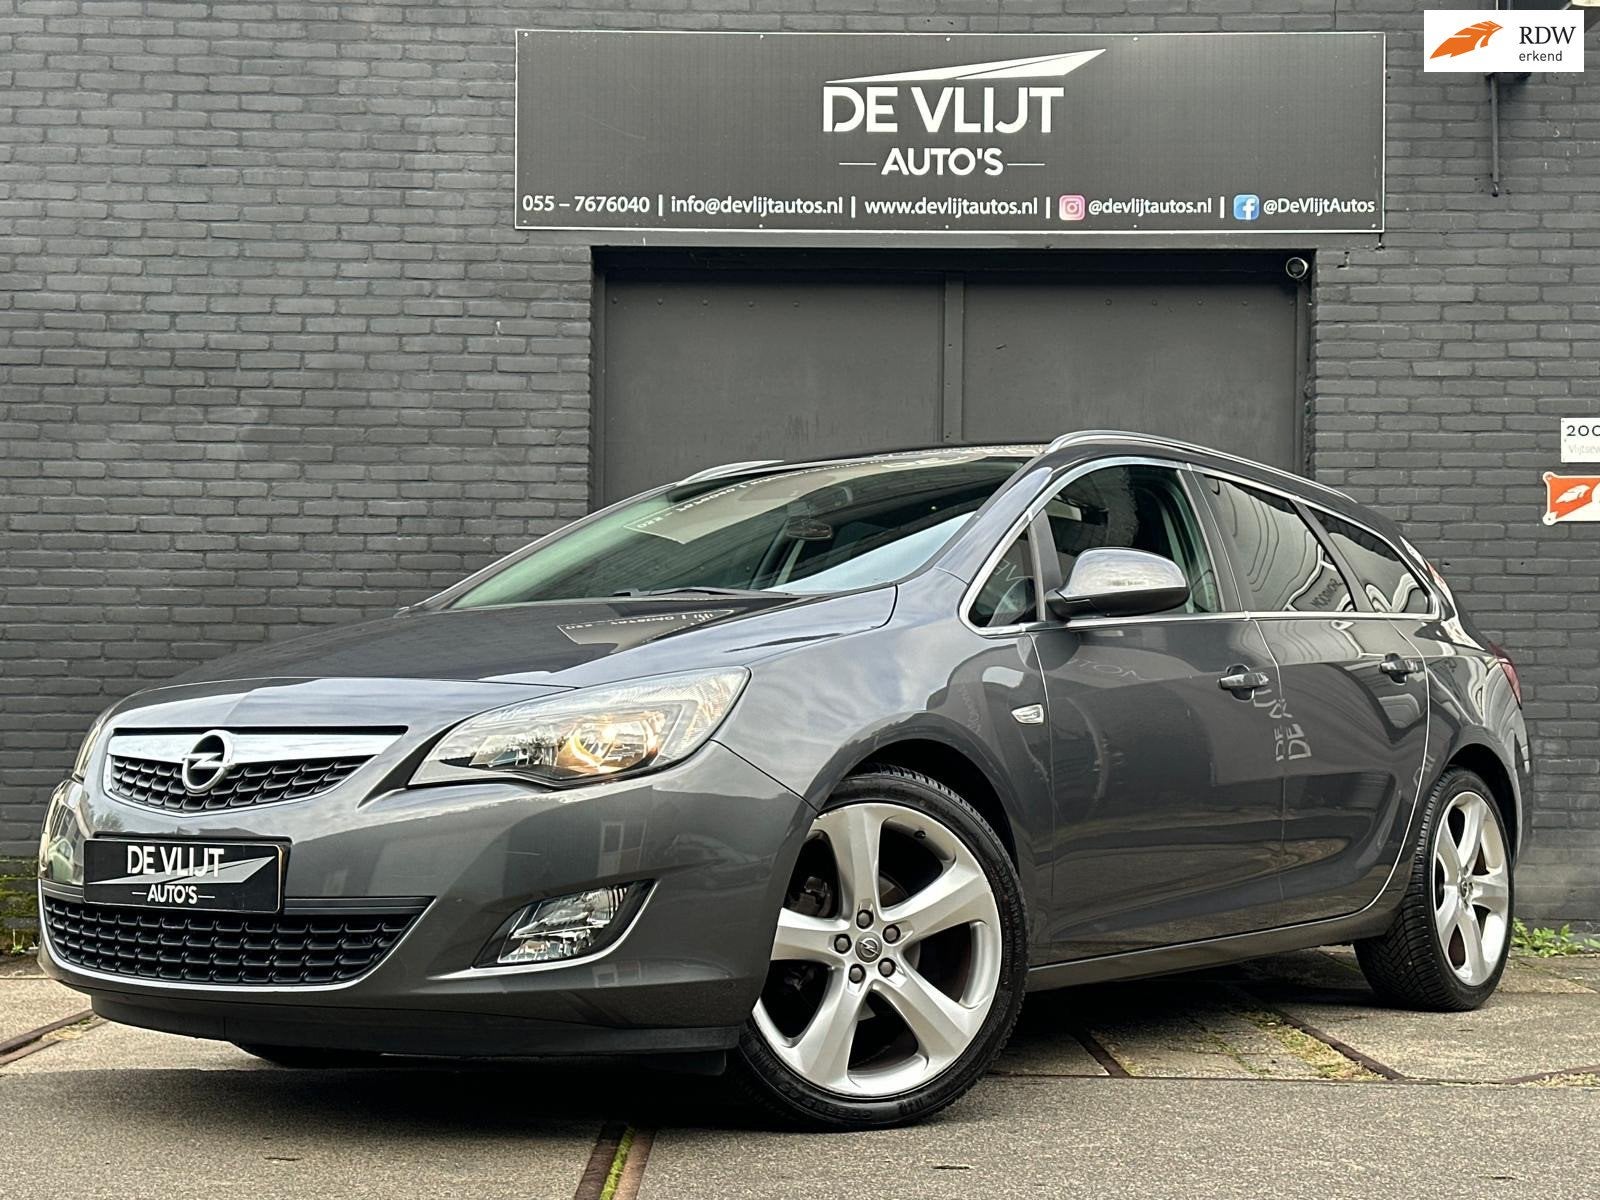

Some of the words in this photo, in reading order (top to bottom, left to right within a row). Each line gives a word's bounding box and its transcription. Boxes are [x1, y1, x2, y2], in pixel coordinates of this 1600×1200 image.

[822, 86, 899, 133] DE
[910, 86, 1065, 134] VLIJT
[880, 147, 1004, 176] AUTO'S
[522, 195, 555, 212] 055
[574, 195, 651, 213] 7676040
[671, 194, 843, 218] info@devlijtautos.nl
[864, 196, 1038, 219] www.devlijtautos.nl
[1088, 197, 1212, 219] @devlijtautos.nl
[1263, 197, 1376, 218] @DeVlijtAutos
[126, 844, 156, 875] DE
[159, 846, 225, 878] VLIJT
[146, 883, 199, 905] AUTO'S
